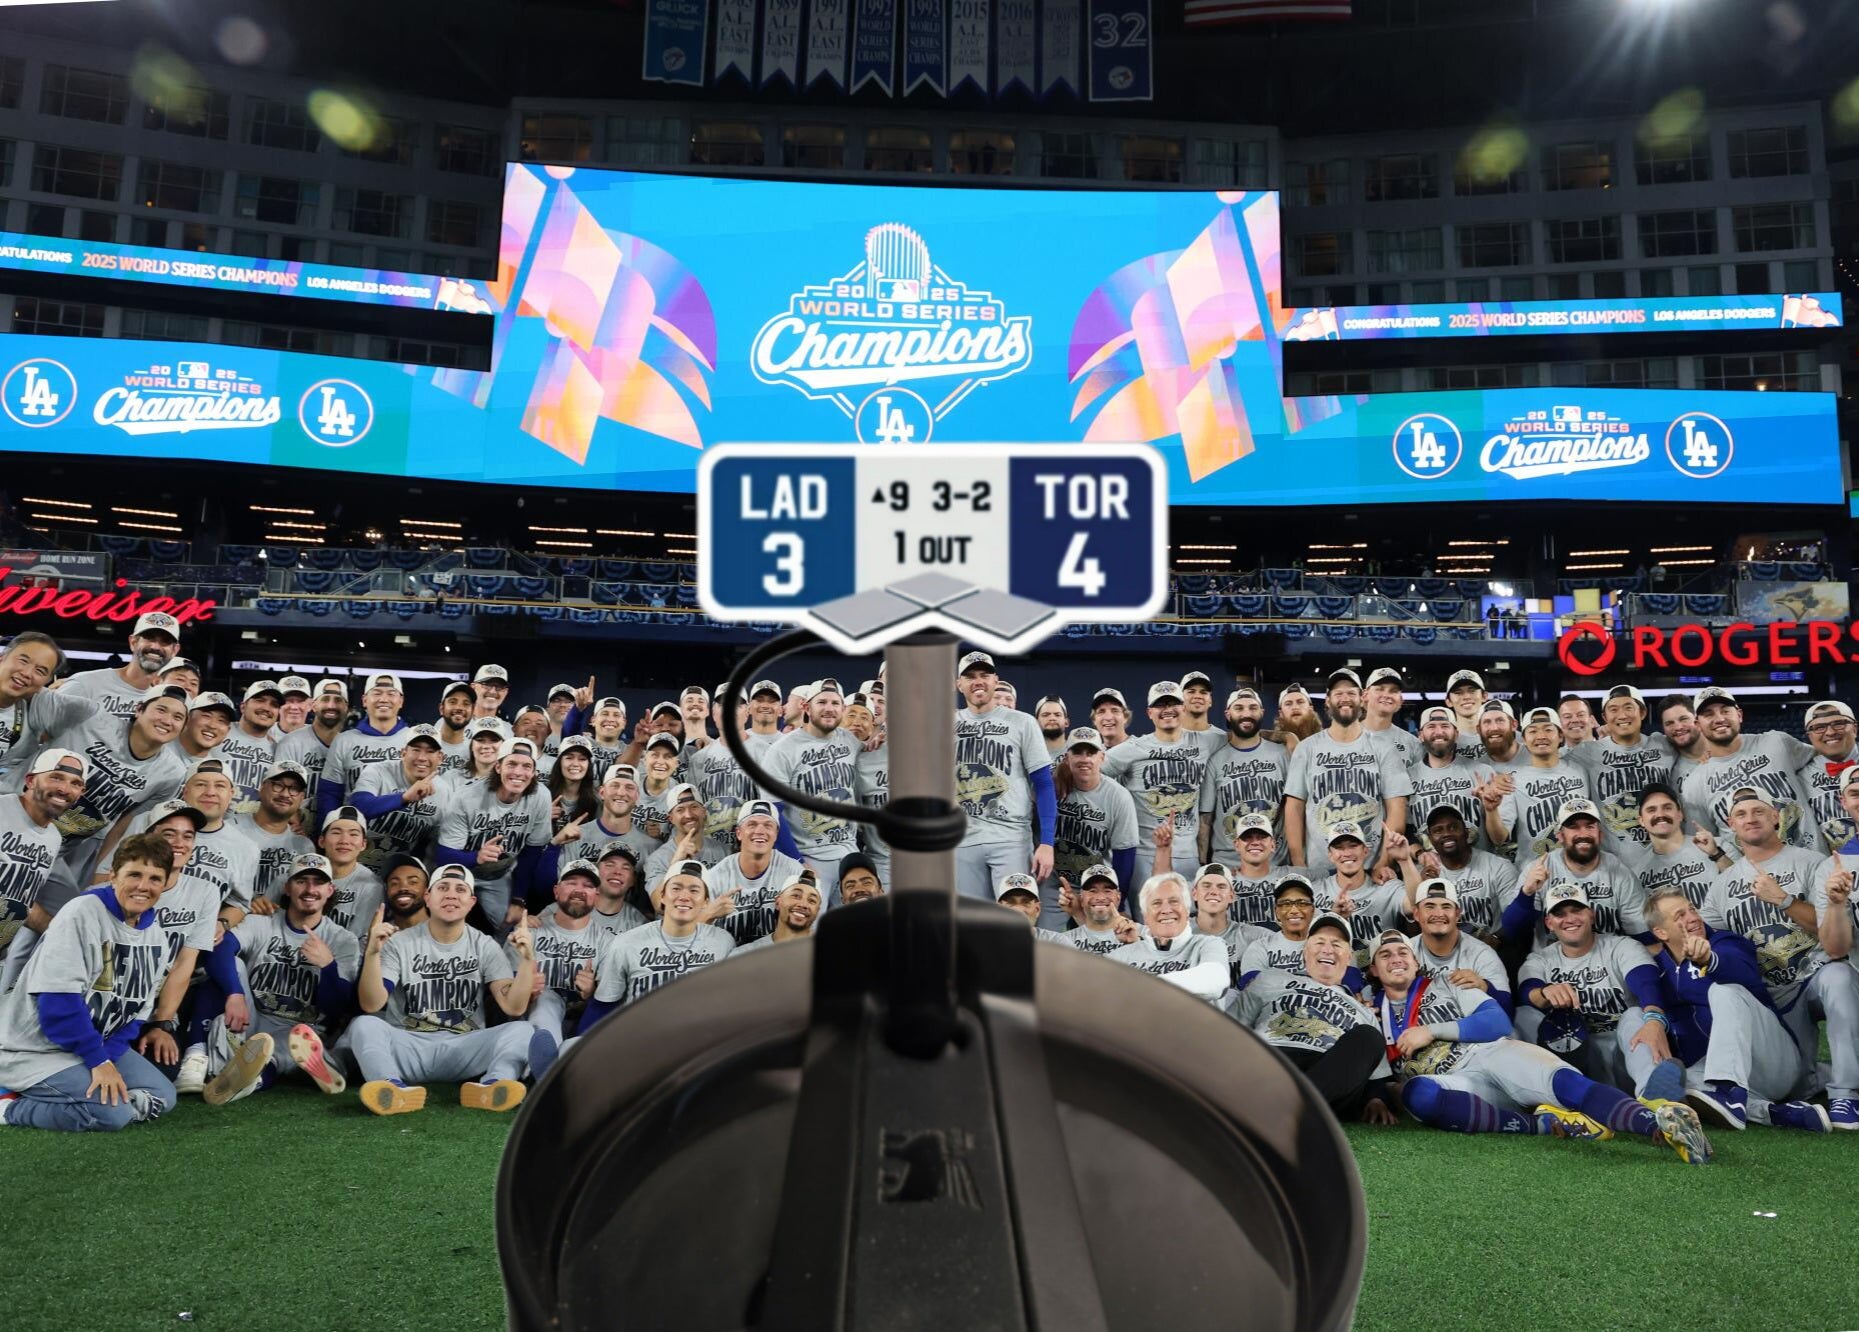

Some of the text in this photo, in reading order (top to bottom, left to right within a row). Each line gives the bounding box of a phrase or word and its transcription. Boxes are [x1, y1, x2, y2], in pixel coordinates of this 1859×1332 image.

[953, 1, 988, 19] 2015
[1093, 12, 1148, 48] 32
[81, 252, 298, 288] 2025 WORLD SERIES CHAMPIONS
[307, 276, 431, 300] LOS ANGELES DODGERS
[836, 284, 959, 301] 20 25
[799, 300, 996, 321] WORLD SERIES
[1343, 316, 1440, 330] CONGRATULATIONS
[1448, 309, 1646, 329] 2025 WORLD SERIES CHAMPIONS
[1653, 307, 1776, 322] LOS ANGELES DODGERS
[757, 317, 1026, 386] Champions
[150, 366, 171, 376] 20
[19, 367, 58, 416] LA
[124, 376, 262, 395] WORLD SERIES
[93, 386, 281, 434] Champions
[318, 386, 355, 437] LA
[1504, 421, 1630, 434] WORLD SERIES
[1410, 421, 1445, 468] LA
[1480, 433, 1650, 480] Champions
[1683, 420, 1717, 467] LA
[741, 475, 827, 519] LAD
[890, 481, 992, 512] 9 3-2
[1035, 475, 1130, 519] TOR
[895, 531, 972, 564] 1 OUT
[762, 533, 804, 596] 3
[1058, 533, 1105, 596] 4
[1633, 620, 1859, 668] ROGER
[977, 720, 1009, 739] Series
[352, 745, 387, 760] World
[955, 737, 1014, 776] AMPIONS
[1316, 752, 1376, 770] World Series
[1222, 759, 1277, 778] World Series
[1707, 766, 1740, 793] World
[1736, 753, 1770, 783] Series
[1313, 768, 1381, 804] CHAMPIONS
[1440, 777, 1472, 797] Series
[1525, 781, 1559, 798] World
[829, 827, 850, 843] 2025
[1640, 861, 1705, 888] World Series
[157, 906, 196, 928] Series
[412, 954, 451, 973] World
[564, 941, 597, 962] Series
[640, 947, 714, 973] World Series
